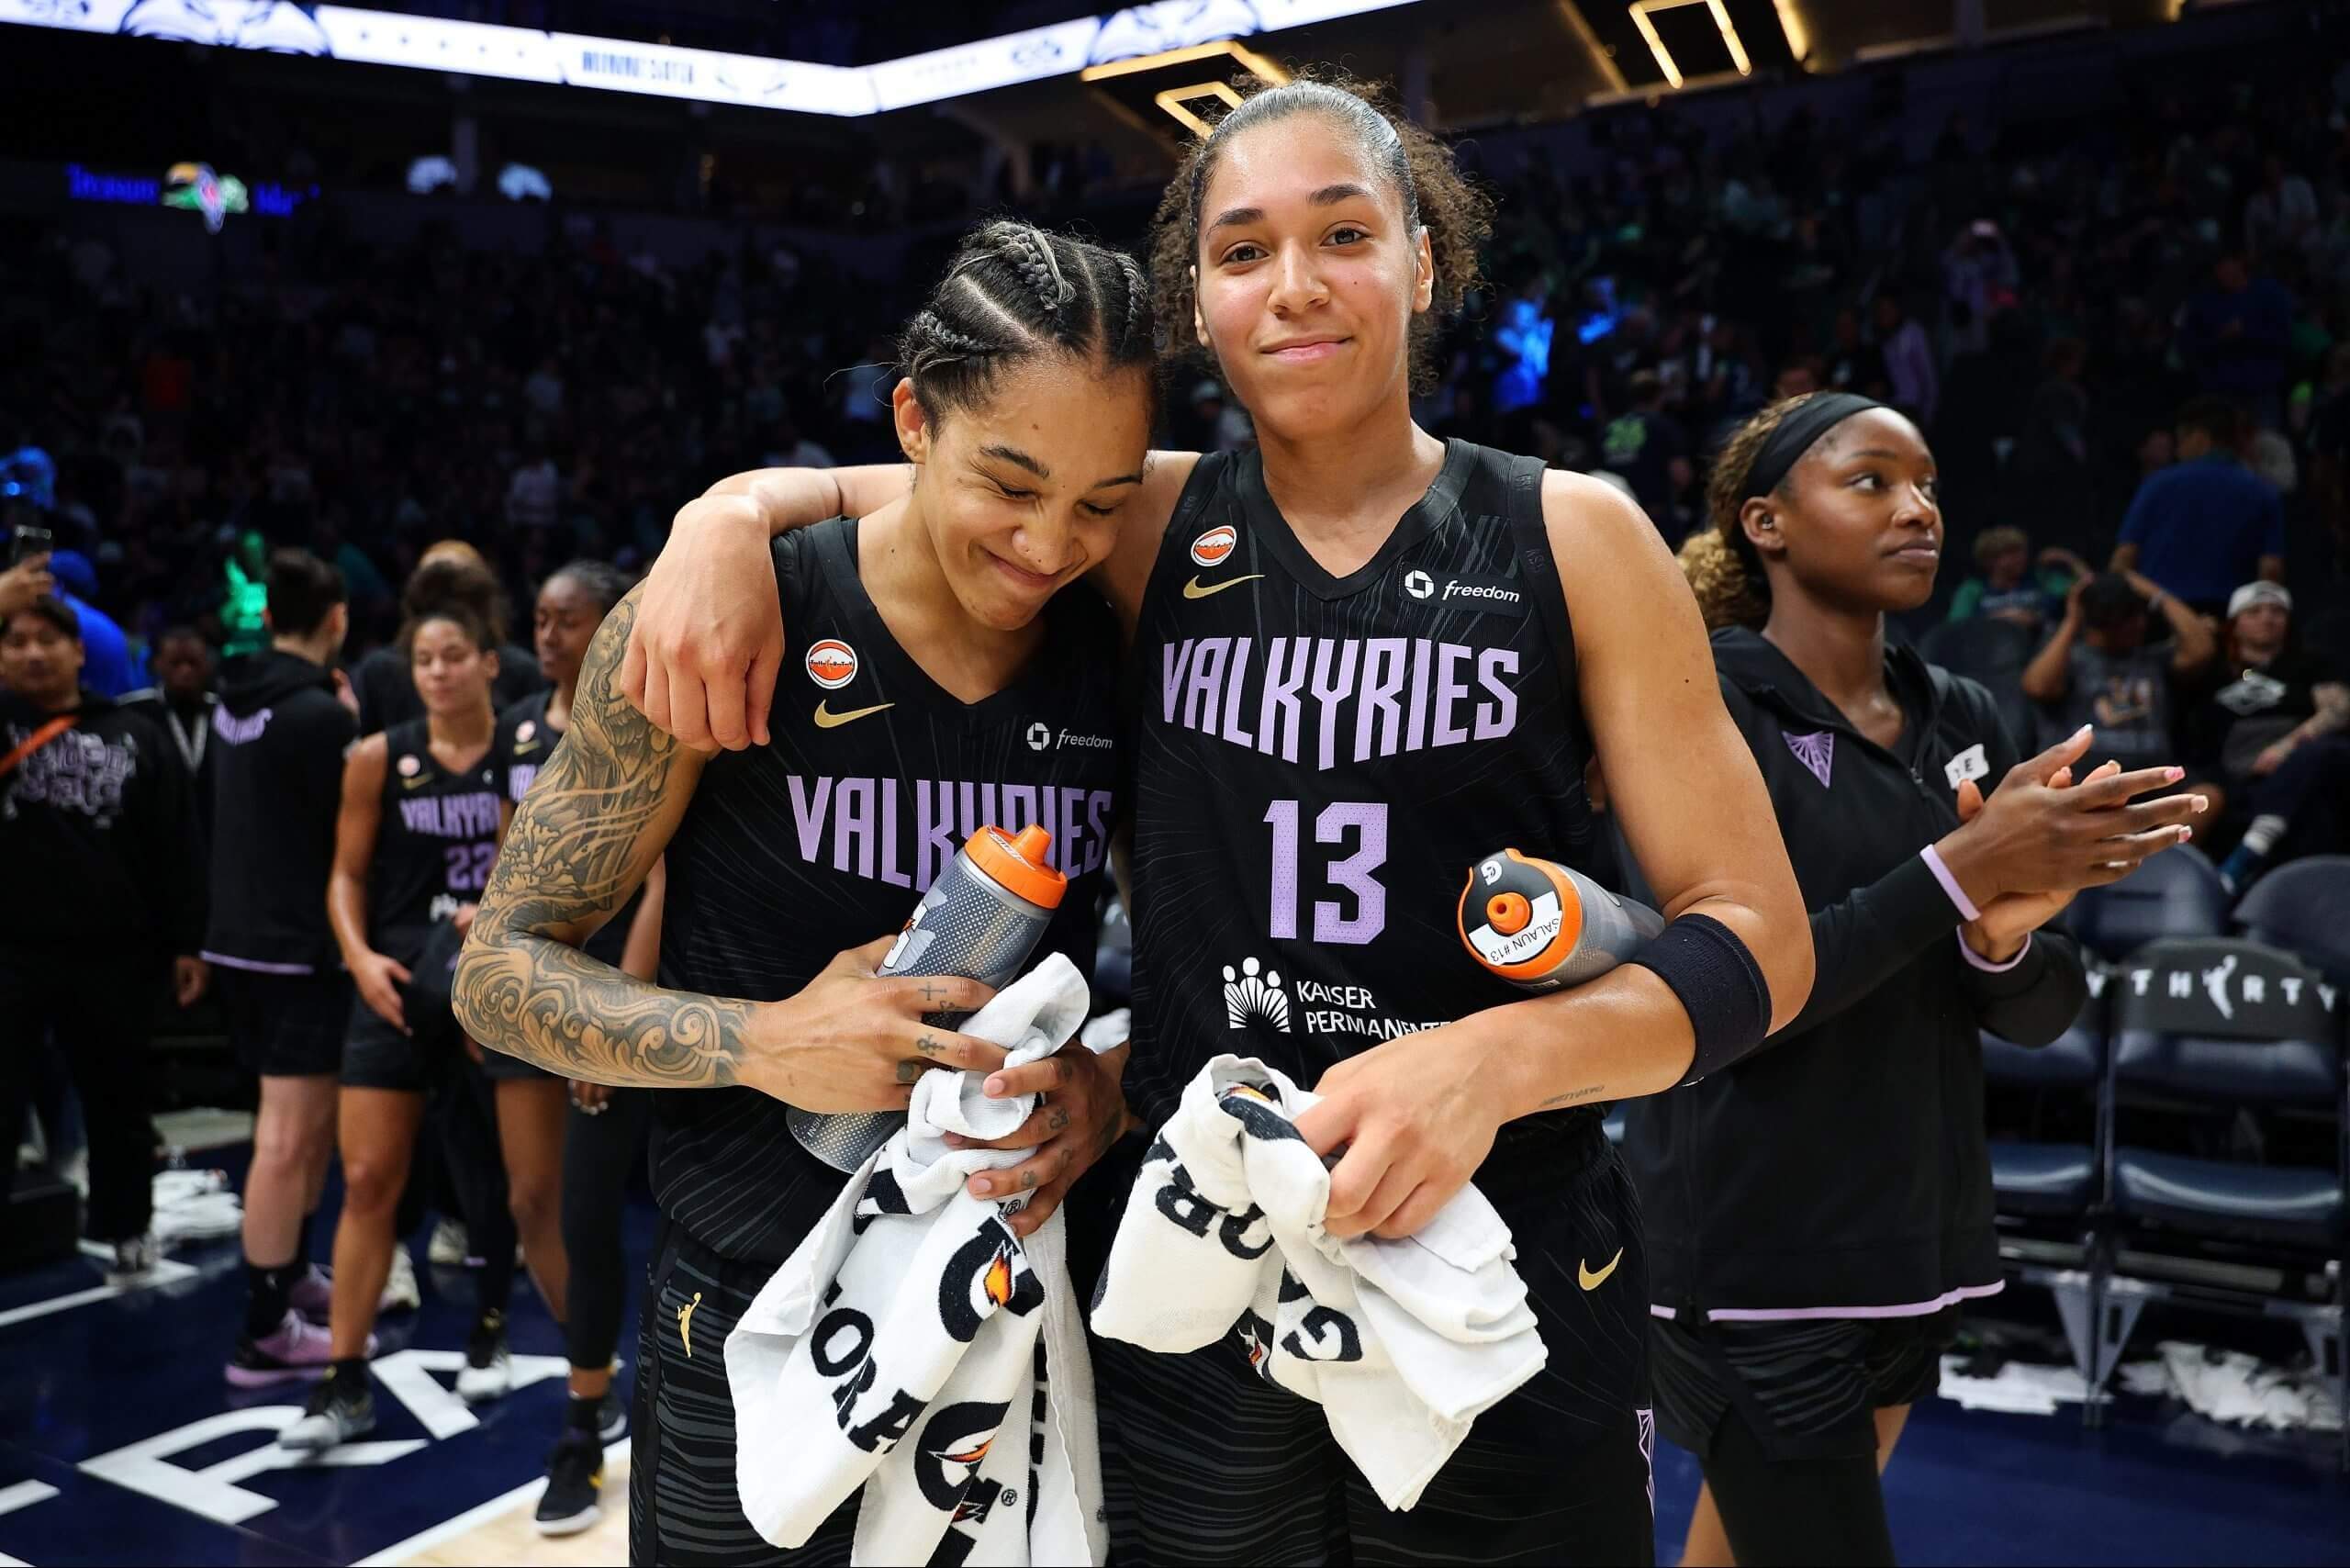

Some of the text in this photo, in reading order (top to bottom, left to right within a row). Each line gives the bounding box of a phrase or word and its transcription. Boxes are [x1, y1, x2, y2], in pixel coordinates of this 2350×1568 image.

[1442, 579, 1521, 603] freedom
[1162, 636, 1520, 772] VALKYRIES
[1057, 728, 1113, 750] freedom
[444, 841, 497, 891] 22
[1263, 800, 1389, 946] 13
[1489, 917, 1560, 962] SALAUN #13
[1296, 980, 1377, 1010] KAISER
